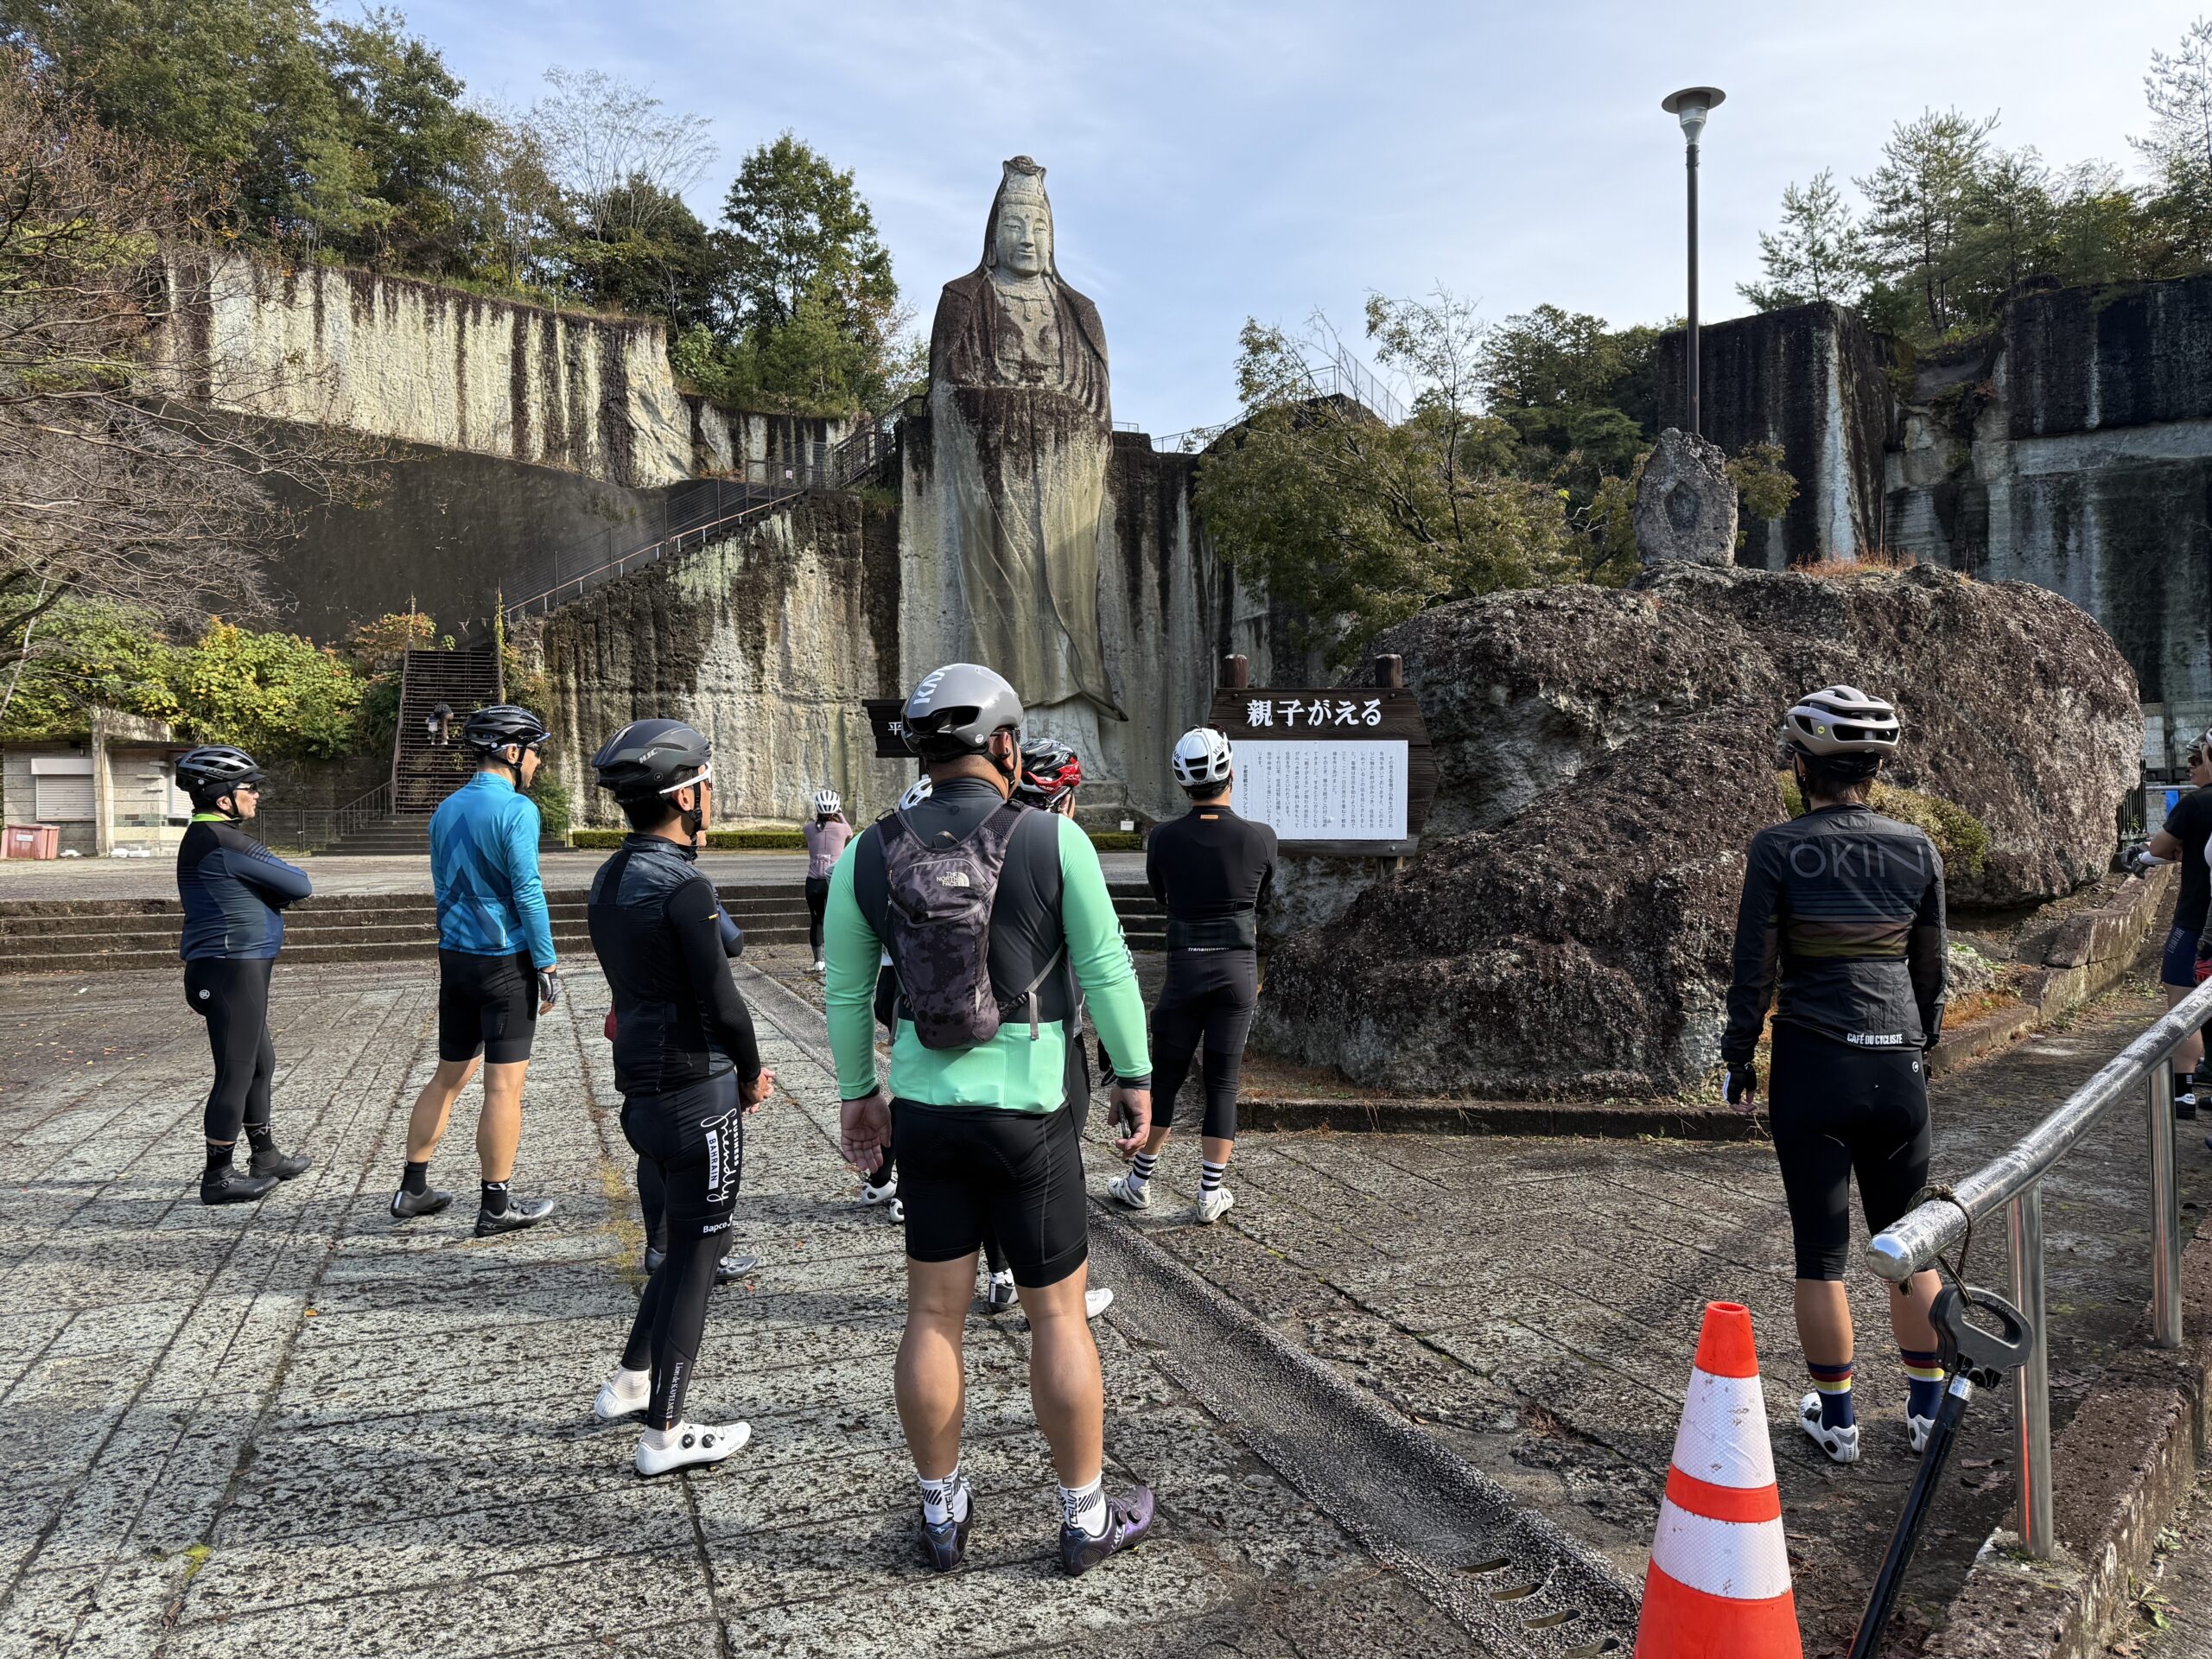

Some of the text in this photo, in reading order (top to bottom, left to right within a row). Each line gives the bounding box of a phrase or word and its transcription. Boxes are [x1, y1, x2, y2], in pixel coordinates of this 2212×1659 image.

[1247, 698, 1382, 727] 親子がえる
[639, 747, 658, 764] HJC
[1847, 1033, 1903, 1045] CAFÉ DU CYCLISTE
[709, 1137, 718, 1182] BAHRAIN
[702, 1222, 728, 1234] Bapco
[673, 1362, 683, 1376] Lion
[1111, 1528, 1122, 1550] LAKE
